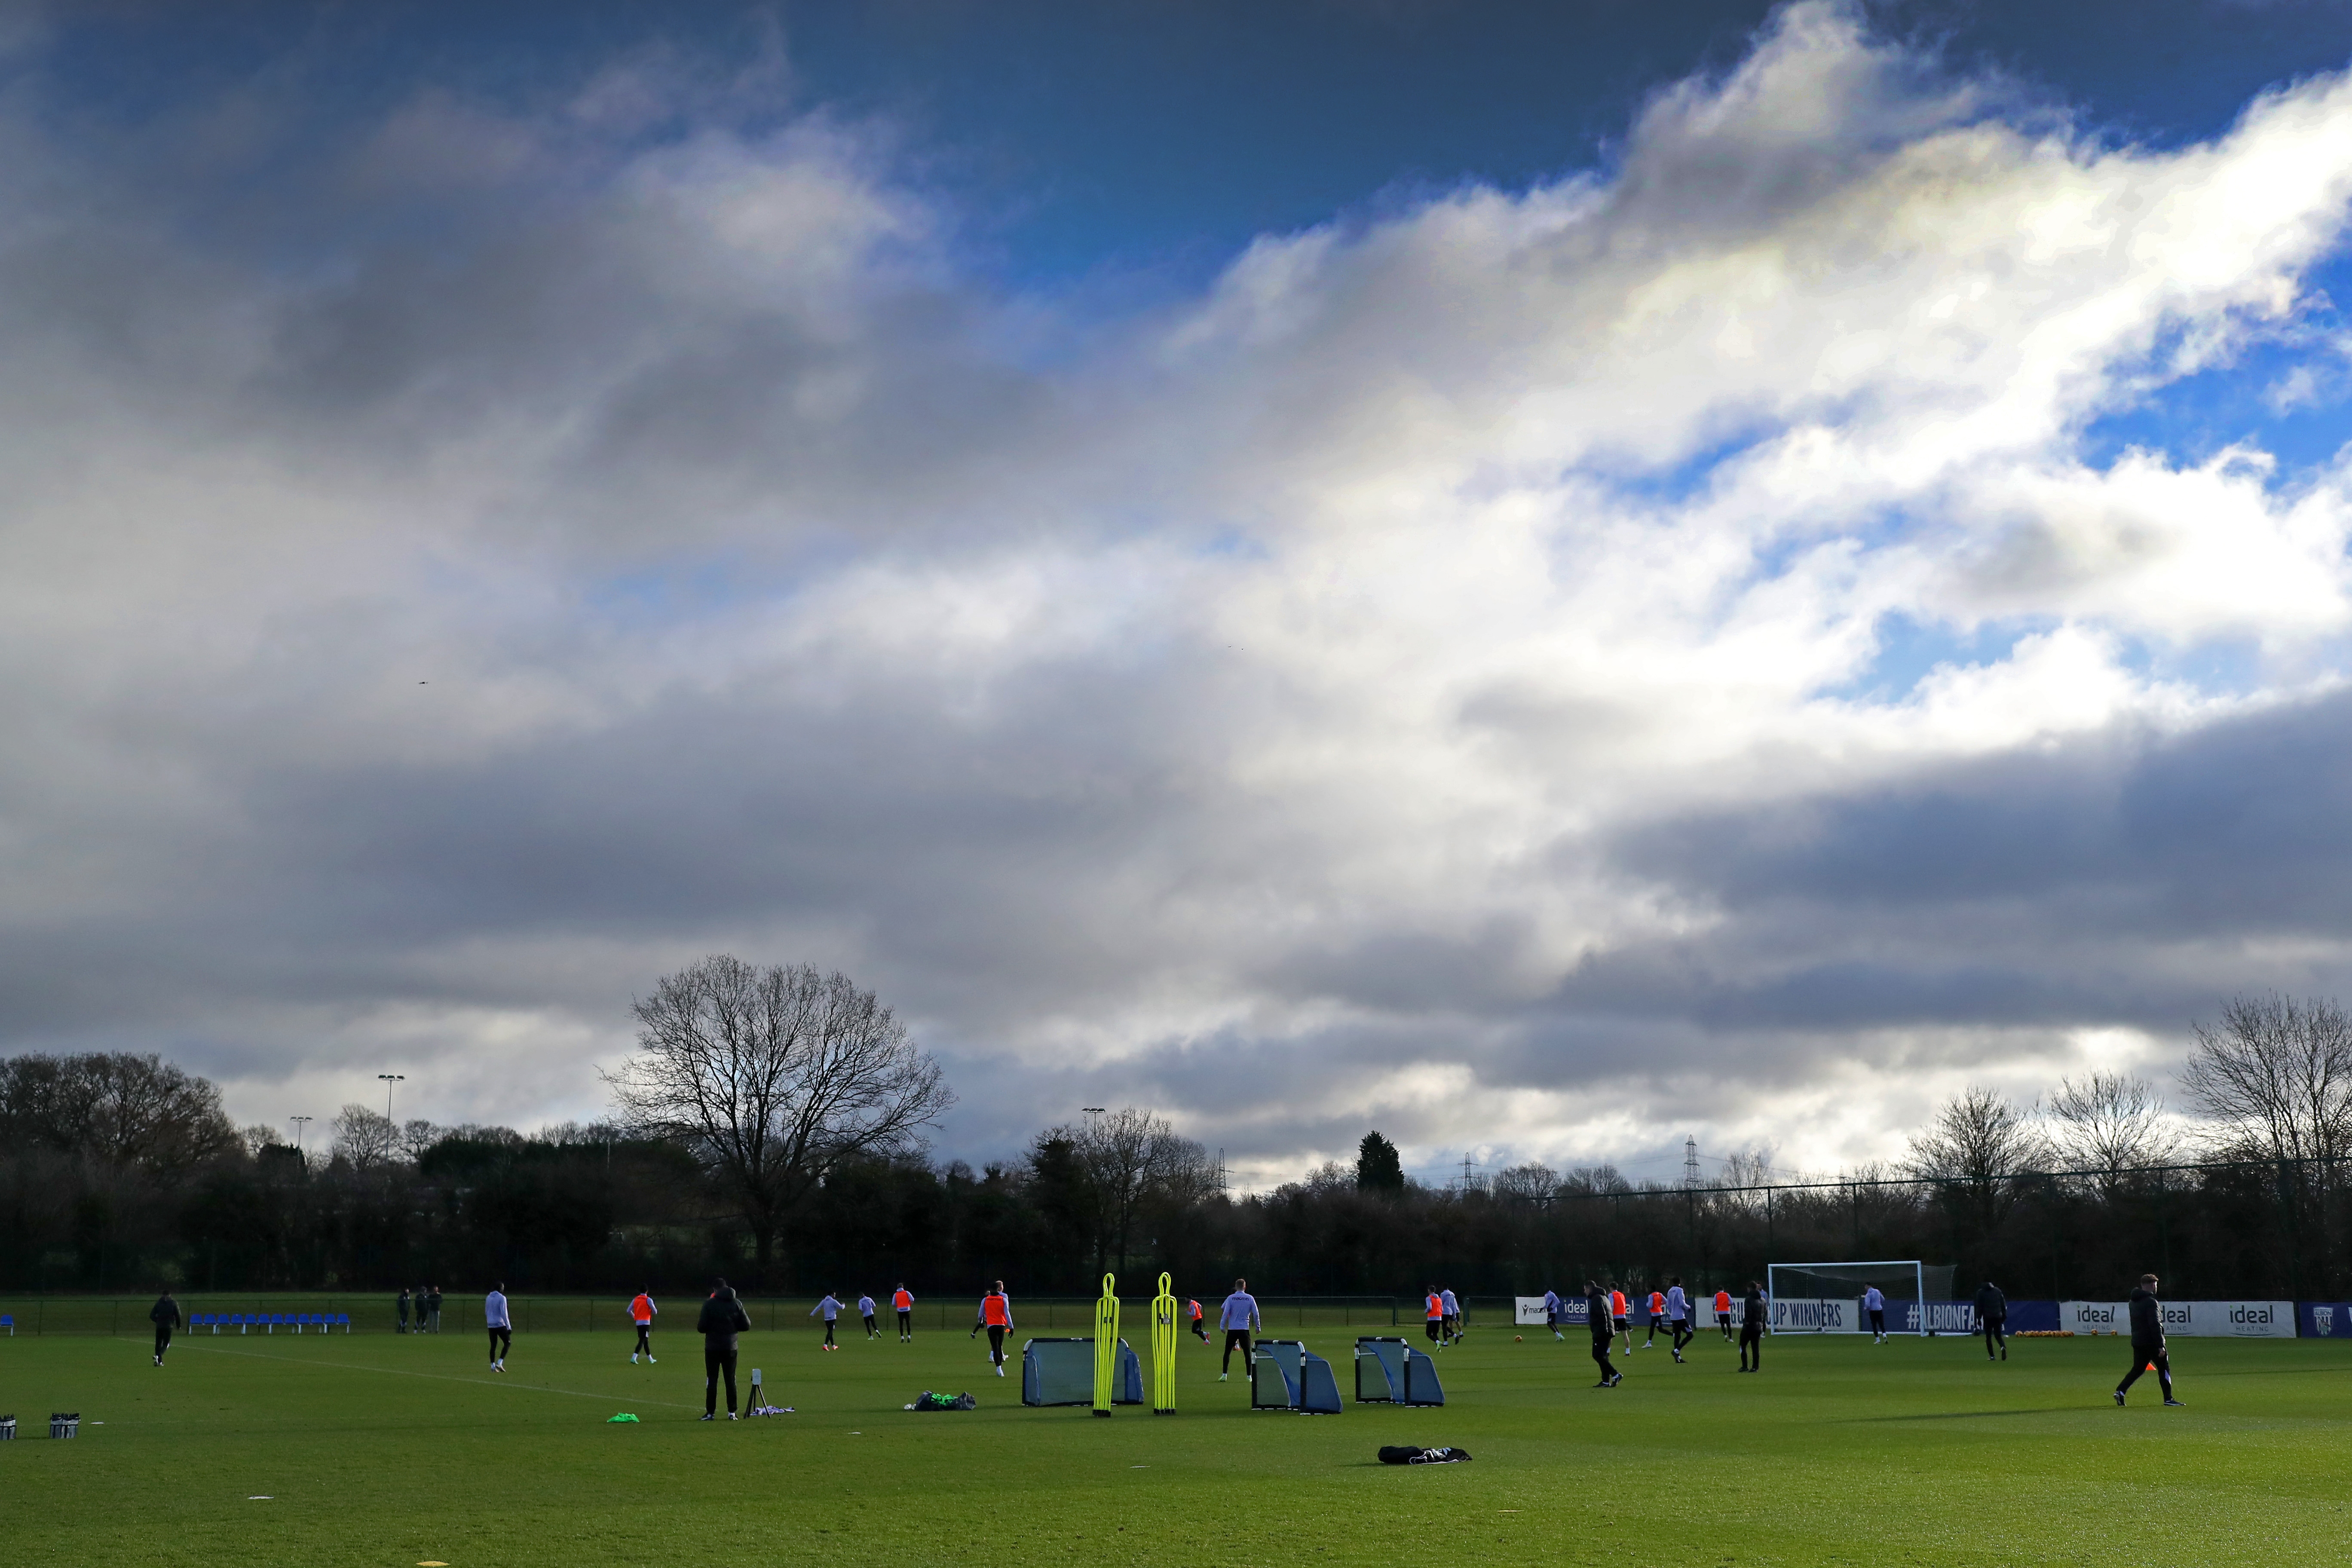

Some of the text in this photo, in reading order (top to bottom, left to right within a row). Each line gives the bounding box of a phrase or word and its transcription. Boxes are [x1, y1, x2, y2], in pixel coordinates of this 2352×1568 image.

[1564, 1299, 1589, 1314] ideal
[1789, 1303, 1841, 1327] WINNERS
[2077, 1305, 2115, 1322] ideal
[2230, 1305, 2273, 1323] ideal
